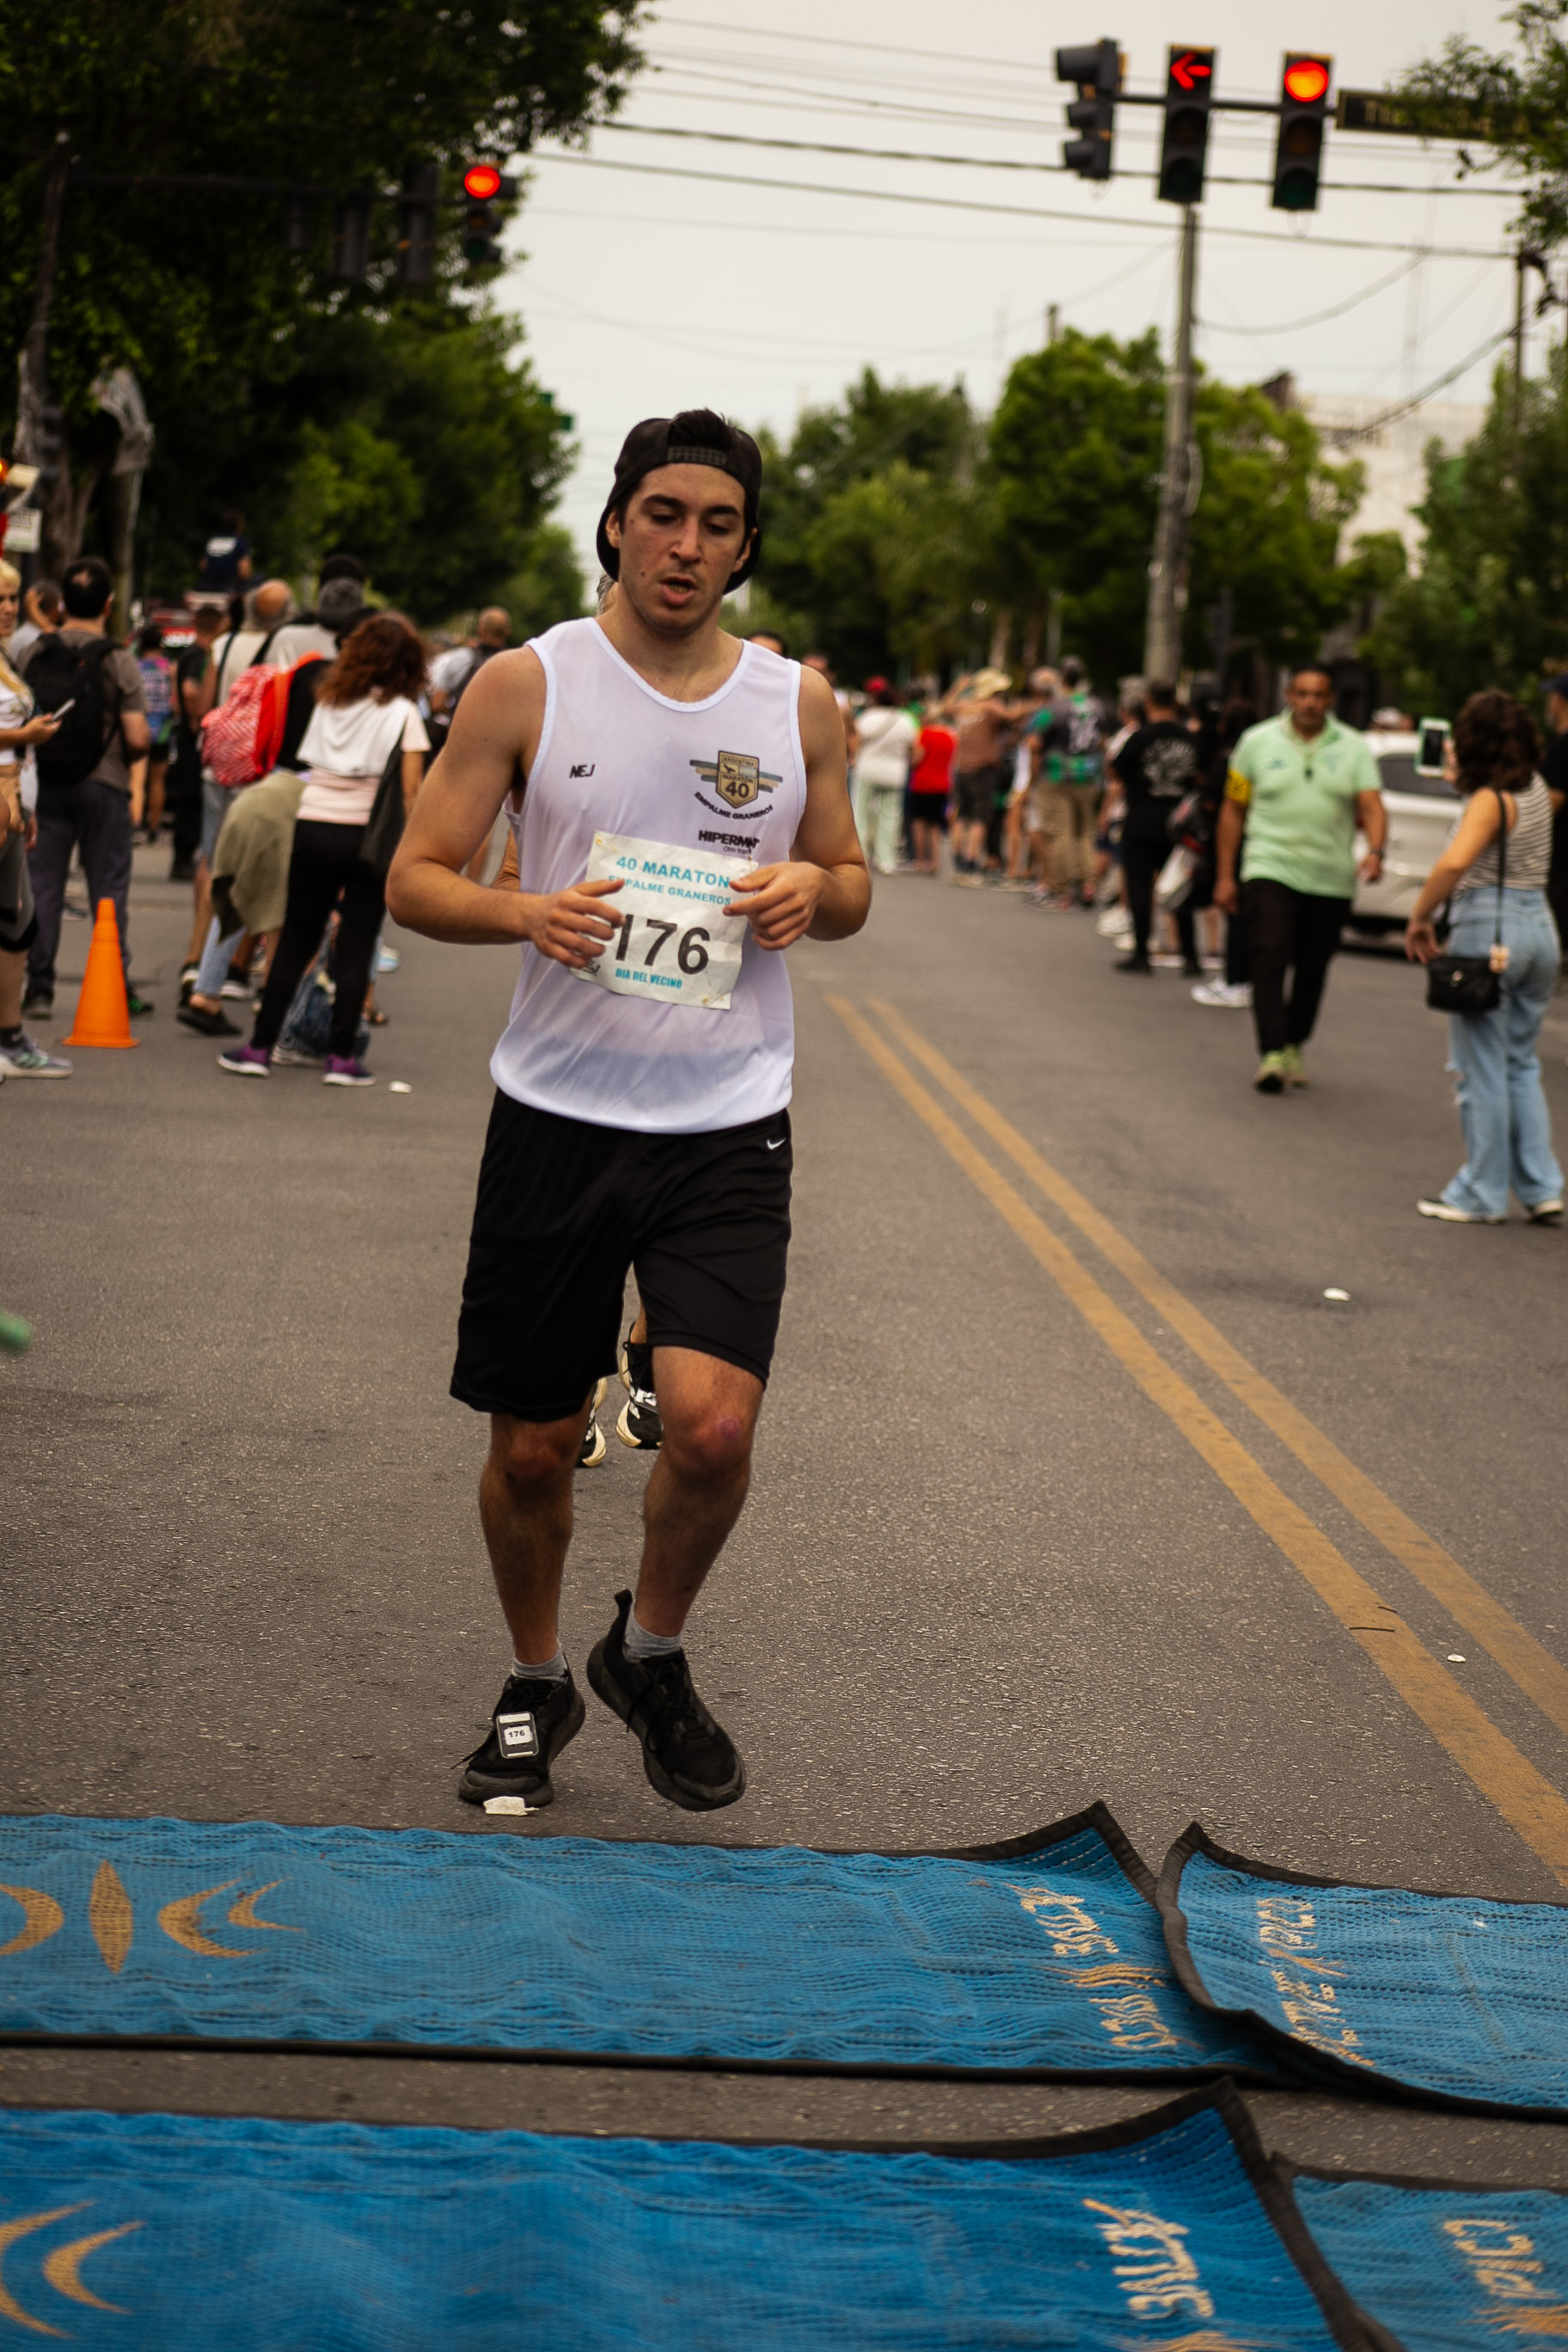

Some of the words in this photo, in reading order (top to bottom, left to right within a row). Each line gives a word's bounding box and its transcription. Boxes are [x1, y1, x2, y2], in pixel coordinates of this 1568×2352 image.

[569, 764, 596, 779] NEJ
[725, 781, 750, 798] 40
[695, 792, 732, 818] EMPALME
[732, 805, 774, 820] GRANEROS
[616, 856, 637, 871] 40
[642, 861, 730, 889] MARATON
[608, 875, 665, 894] EPALME
[667, 886, 732, 907] GRANEROS
[616, 913, 711, 975] 176
[616, 967, 630, 980] DIA
[633, 970, 647, 983] DEL
[650, 973, 683, 989] VECINO
[508, 1730, 525, 1738] 176
